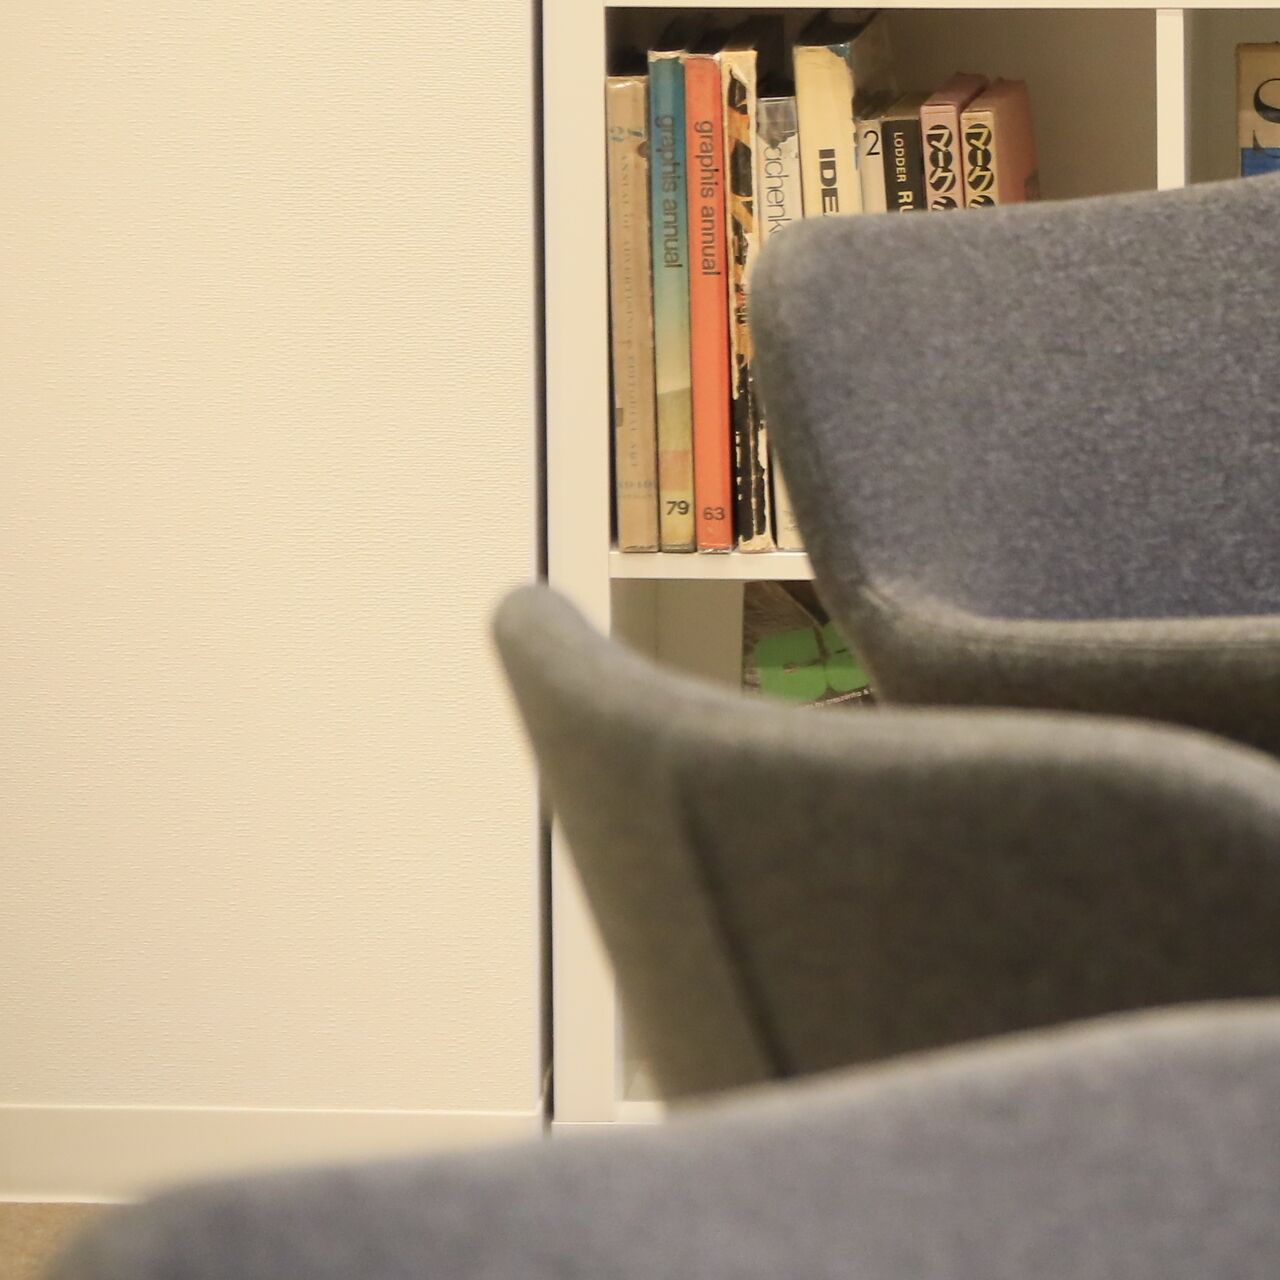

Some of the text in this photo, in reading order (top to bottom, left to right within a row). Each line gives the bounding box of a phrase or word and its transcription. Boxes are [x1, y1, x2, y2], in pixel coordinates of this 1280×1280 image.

[864, 130, 880, 156] 2
[657, 115, 684, 269] graphis annual
[695, 120, 721, 276] graphis annual
[818, 148, 839, 217] IDE
[665, 500, 690, 516] 79
[703, 507, 725, 520] 63
